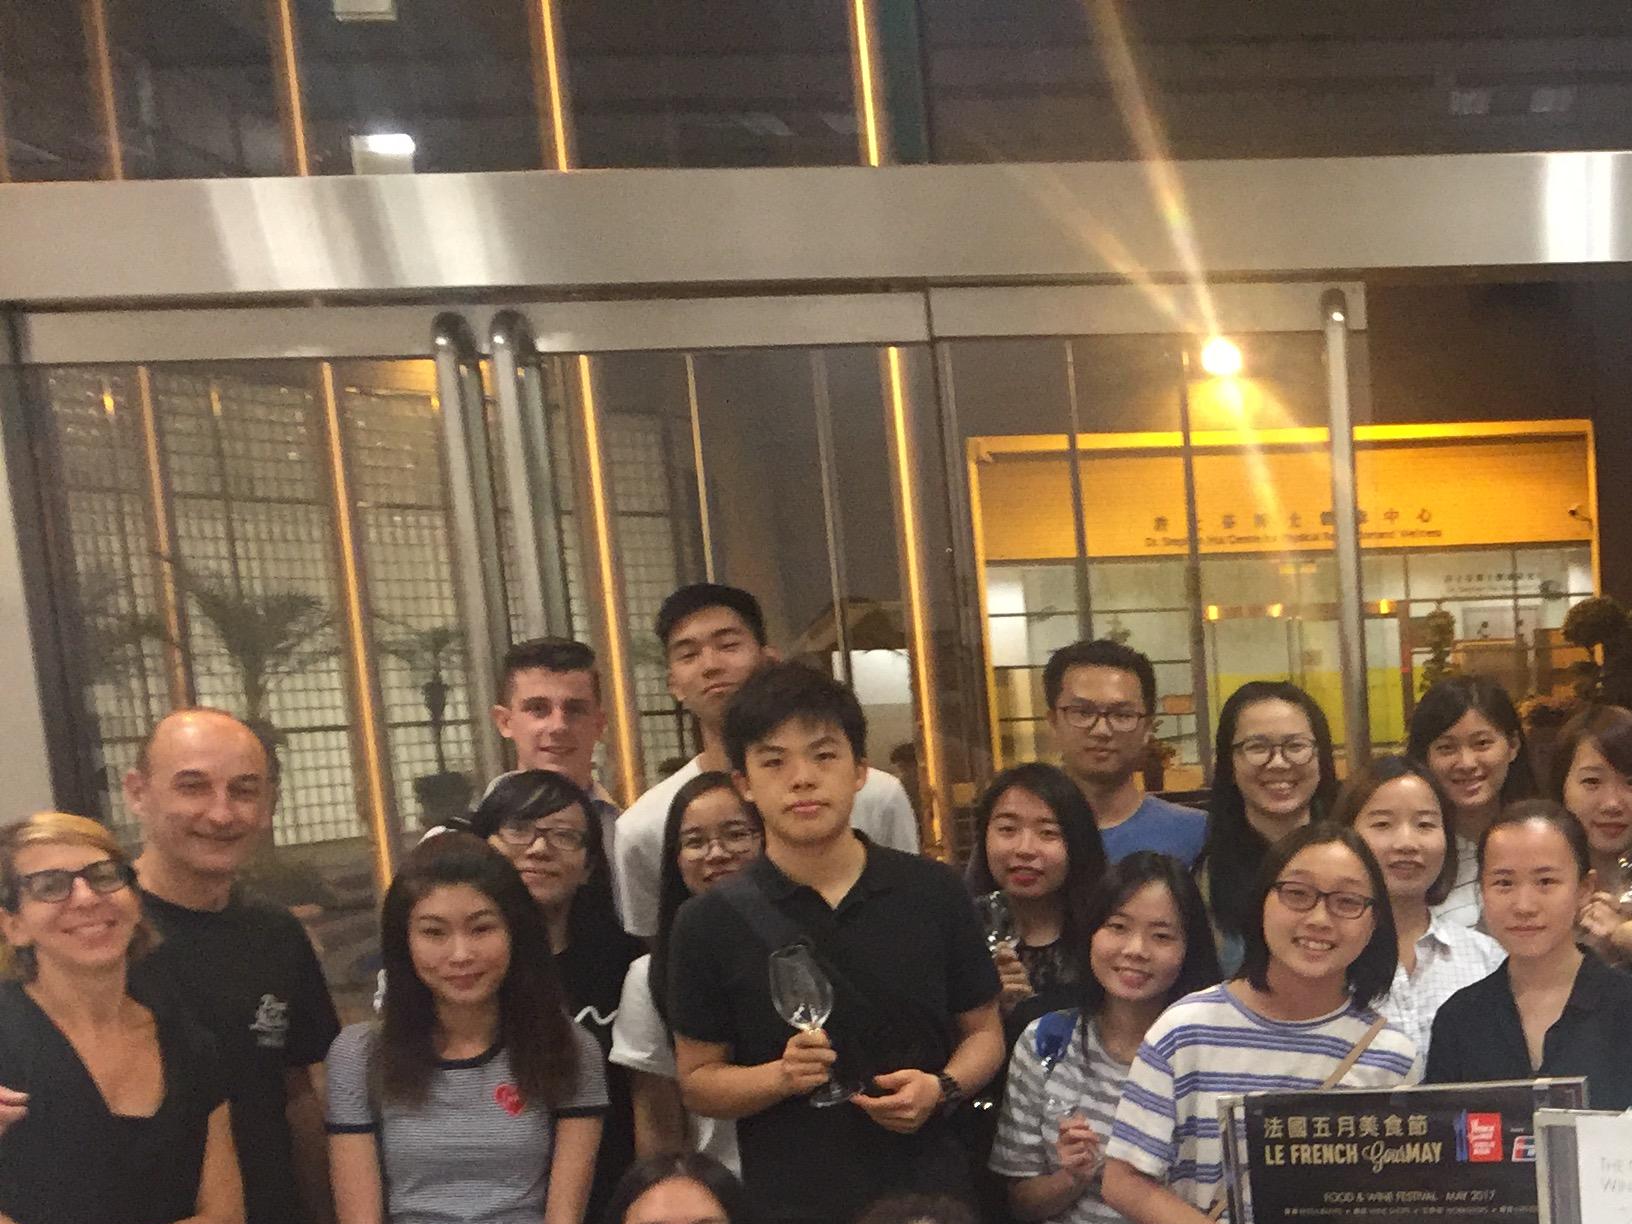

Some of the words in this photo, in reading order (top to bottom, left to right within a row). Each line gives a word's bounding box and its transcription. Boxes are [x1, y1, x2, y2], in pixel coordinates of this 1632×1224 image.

[1264, 1113, 1428, 1139] 法國五月美食節
[1264, 1143, 1285, 1166] LE
[1290, 1142, 1359, 1165] FRENCH
